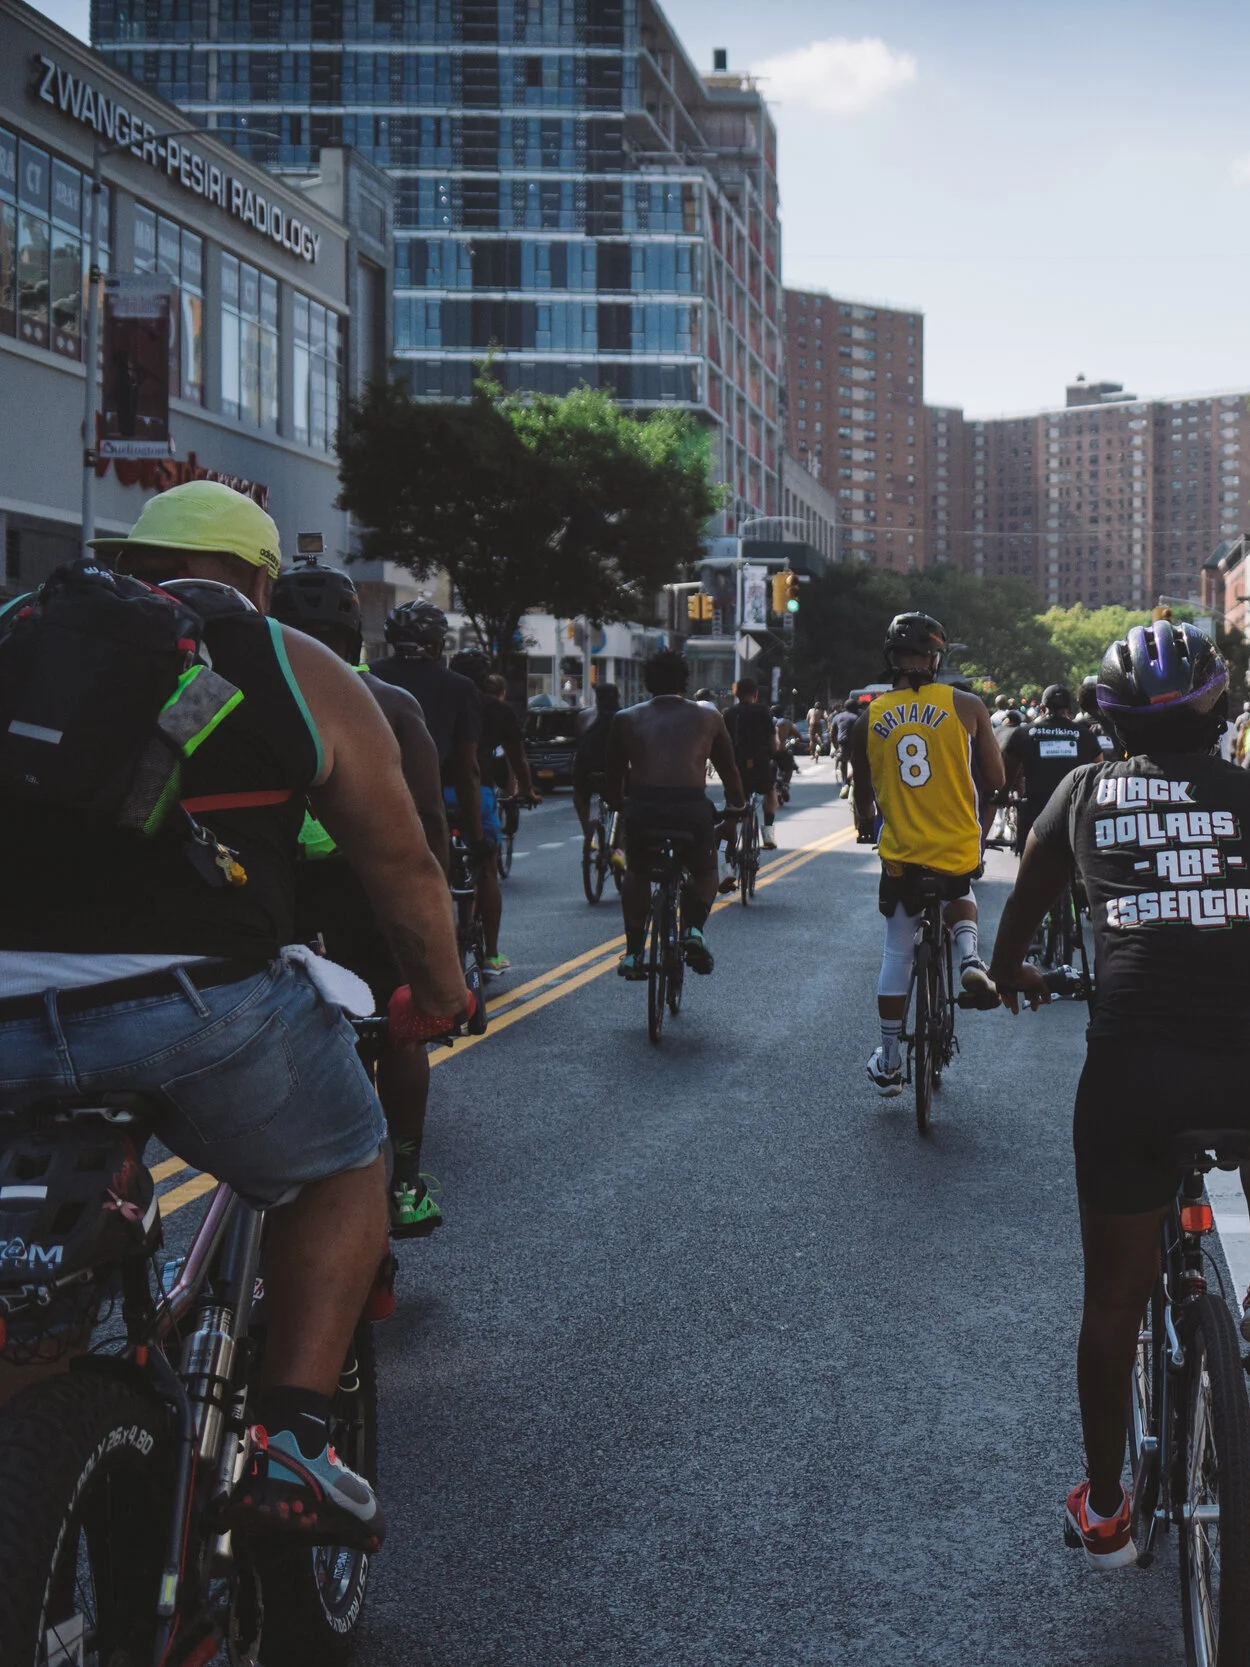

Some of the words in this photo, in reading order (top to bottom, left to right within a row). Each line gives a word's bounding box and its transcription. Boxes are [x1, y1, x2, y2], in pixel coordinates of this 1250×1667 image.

[38, 55, 228, 208] ZWANGER-PESIRI
[231, 177, 322, 264] RADIOLOGY
[872, 702, 950, 740] BRYANT
[896, 733, 932, 788] 8
[1097, 777, 1197, 810] BLACK
[1095, 811, 1239, 849] DOLLARS
